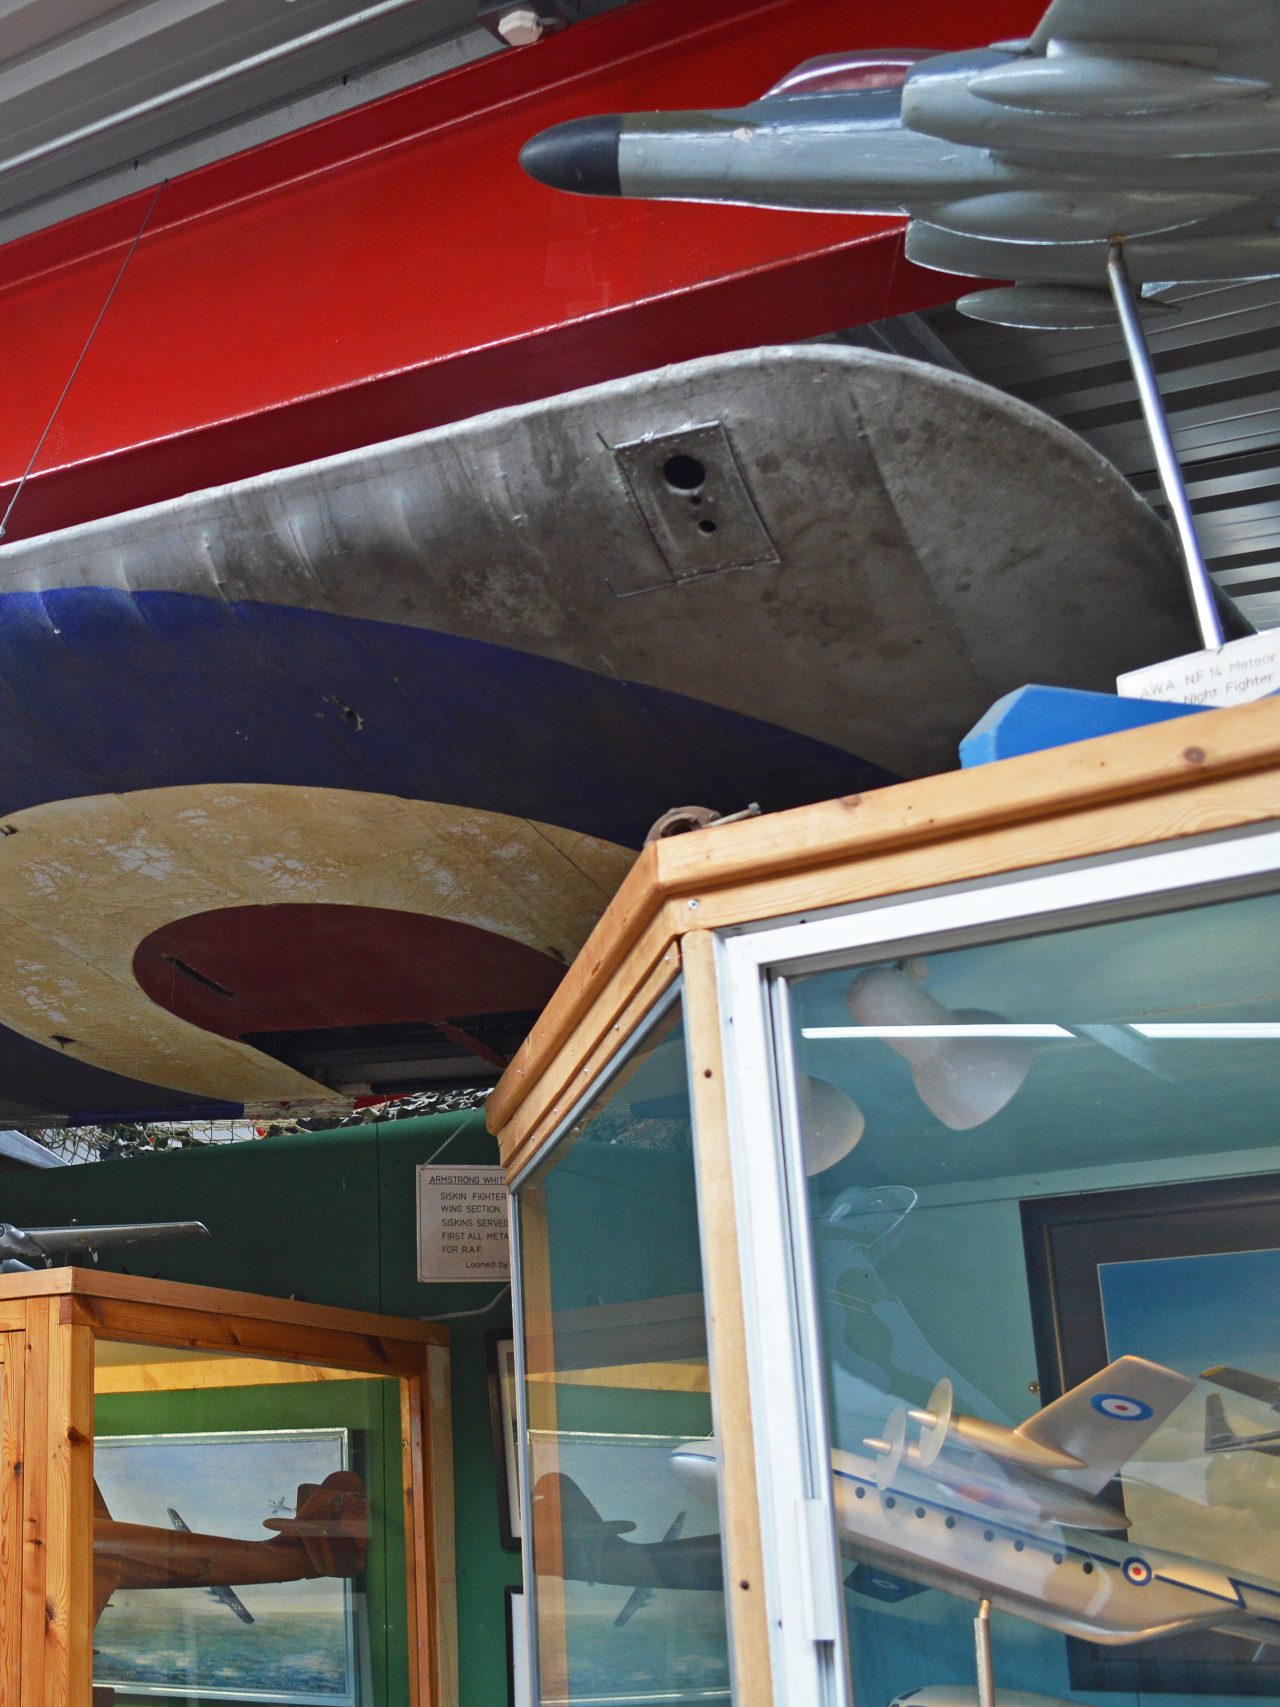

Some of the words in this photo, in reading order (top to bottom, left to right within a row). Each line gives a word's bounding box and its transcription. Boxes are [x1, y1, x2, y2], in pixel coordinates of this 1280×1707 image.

[1229, 653, 1277, 673] Meteor
[1184, 687, 1218, 706] Night
[1225, 672, 1276, 694] Fighter
[429, 1175, 480, 1185] ARMSTRONG
[483, 1176, 506, 1184] WHIT
[440, 1192, 467, 1200] SISKIN
[472, 1192, 507, 1201] FIGHTER
[441, 1205, 463, 1213] WING
[441, 1219, 473, 1227] SISKINS
[476, 1219, 509, 1228] SERVED
[441, 1232, 465, 1240] FIRST
[467, 1232, 483, 1241] ALL
[486, 1233, 509, 1241] META
[442, 1245, 458, 1254] FOR
[466, 1261, 496, 1269] Loaned
[498, 1261, 508, 1270] by
